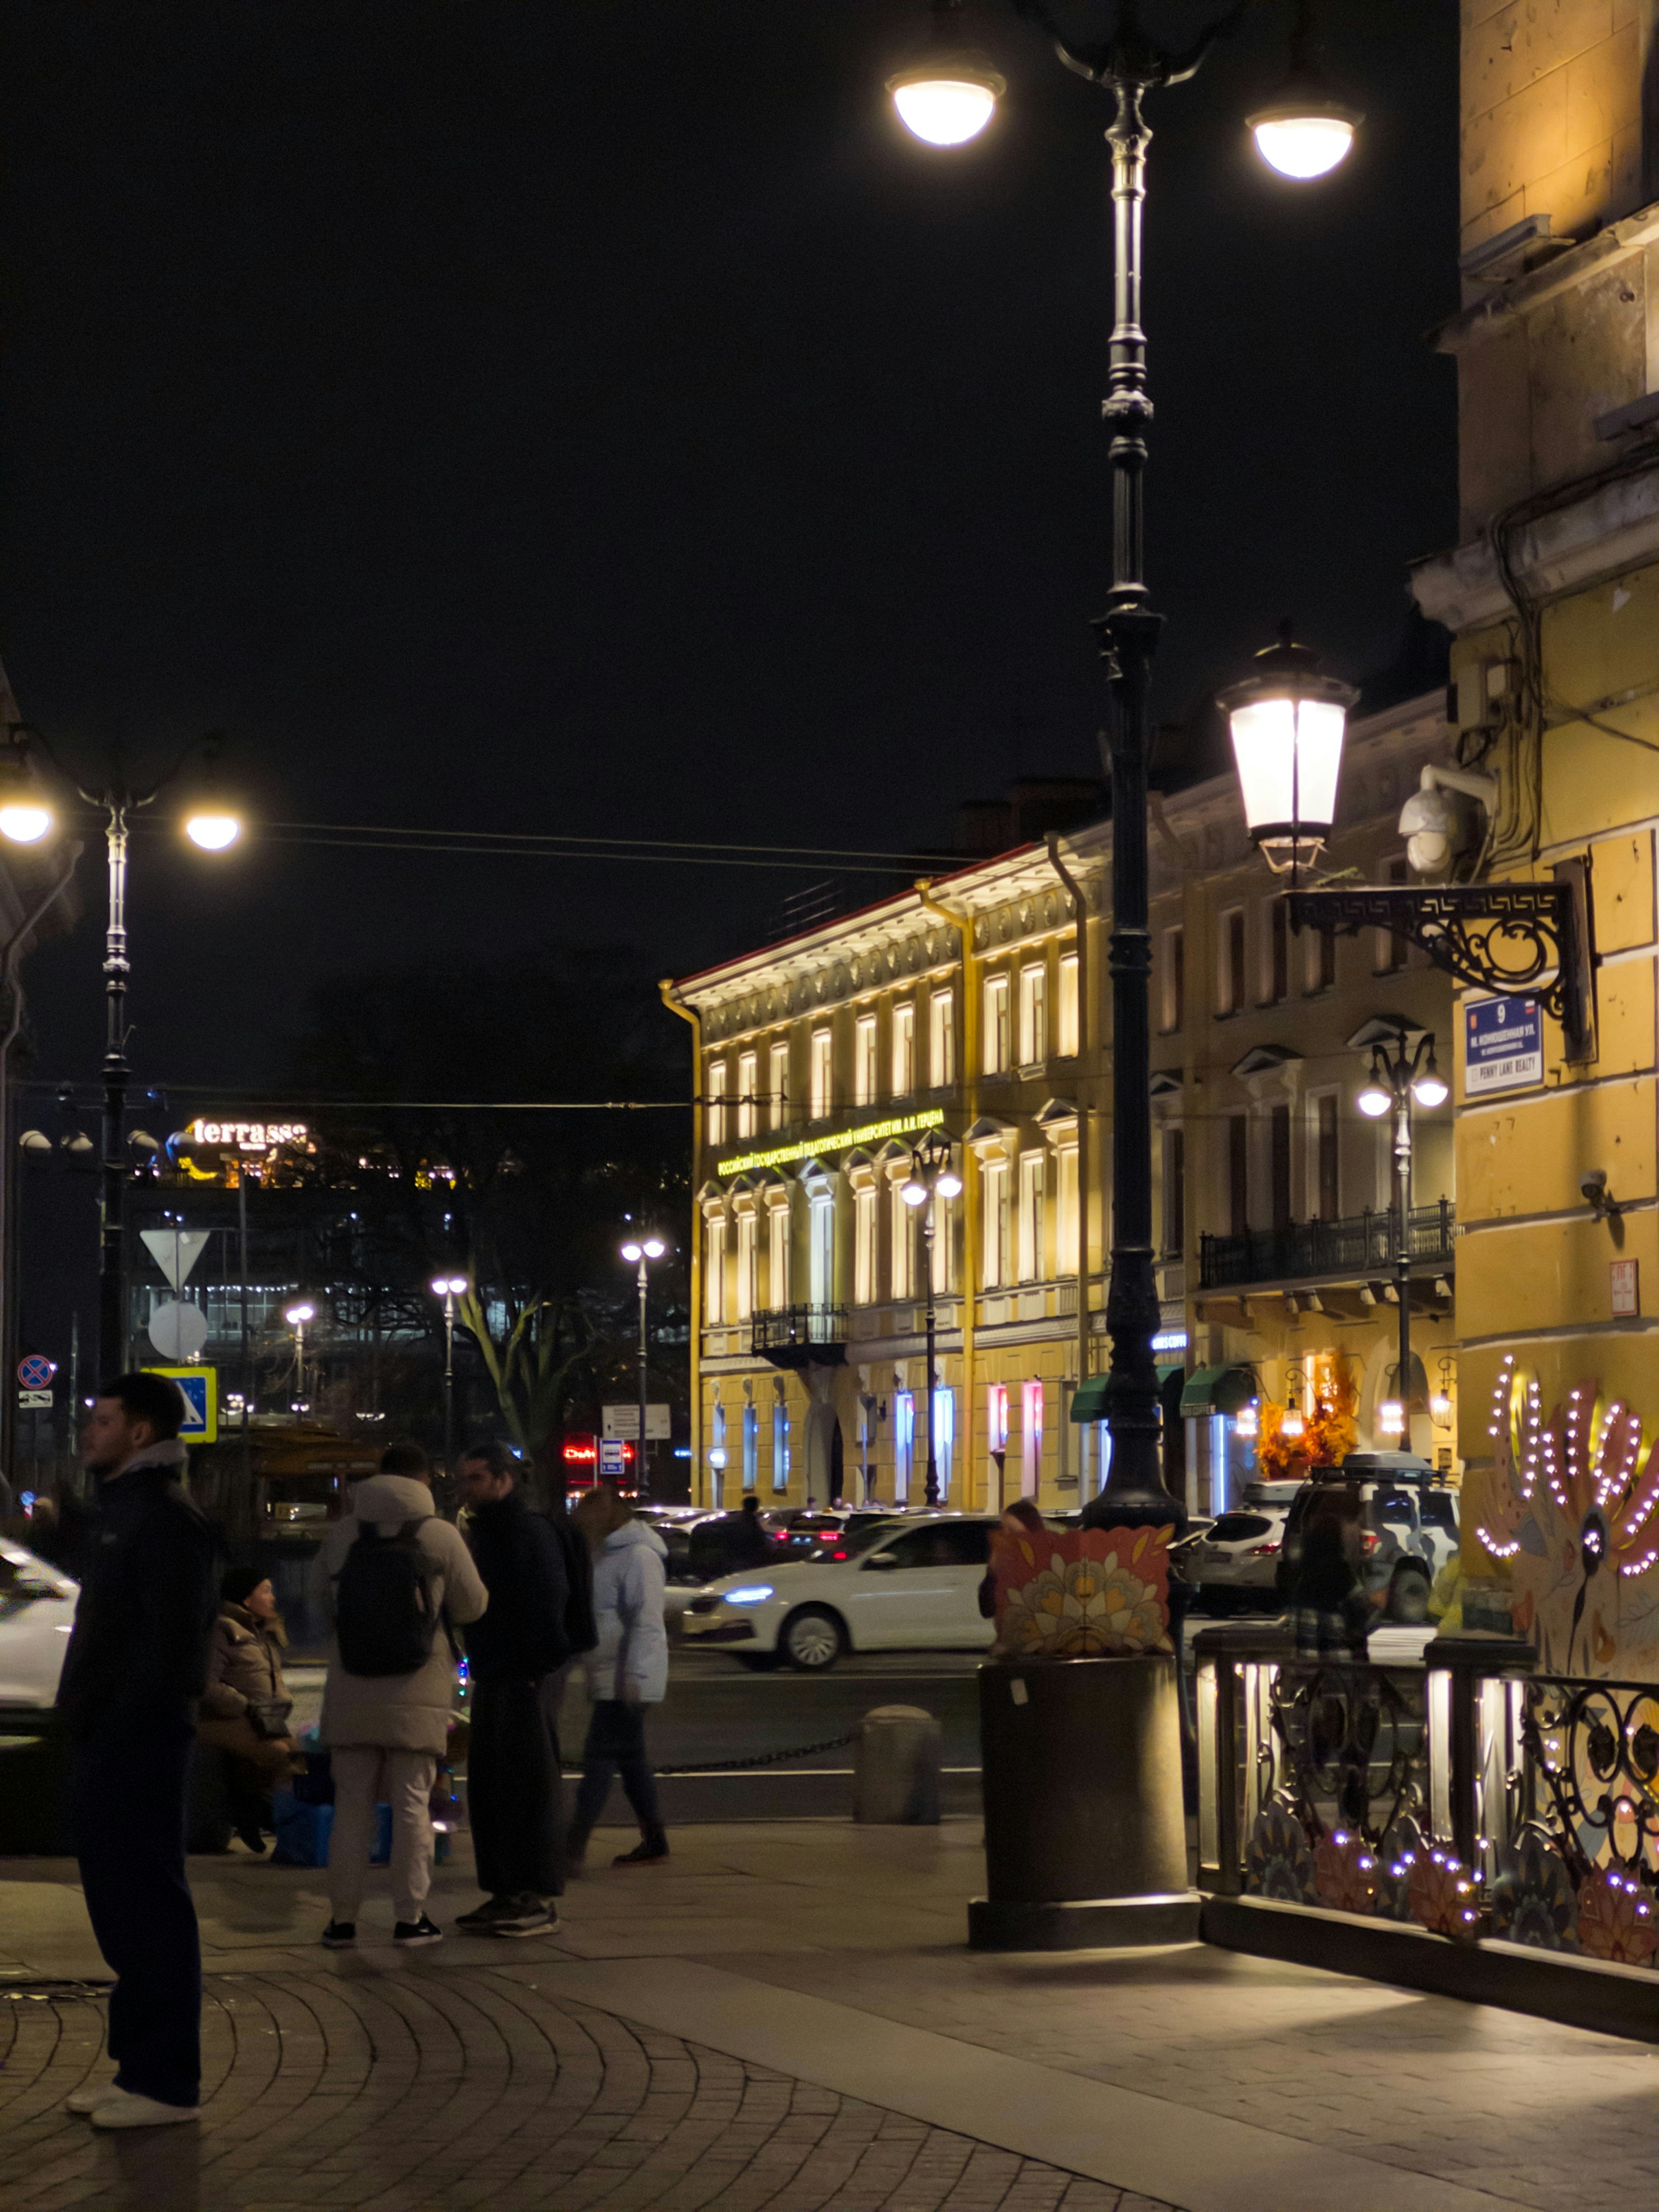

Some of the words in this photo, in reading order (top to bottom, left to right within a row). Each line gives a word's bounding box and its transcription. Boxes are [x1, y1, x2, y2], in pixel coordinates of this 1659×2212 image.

[1497, 1004, 1505, 1024] 9
[1480, 1064, 1498, 1080] PENNY
[1499, 1061, 1513, 1076] LANE
[1515, 1057, 1536, 1073] REALTY
[718, 1152, 754, 1176] РОССИЙСКИЙ
[754, 1141, 804, 1167] ГОСУДАРСТВЕННЫЙ
[804, 1128, 853, 1157] ПЕДАГОГИЧЕСКИЙ
[853, 1120, 891, 1145] УНИВЕРСИТЕТ
[916, 1108, 944, 1128] ГЕРЦЕНА
